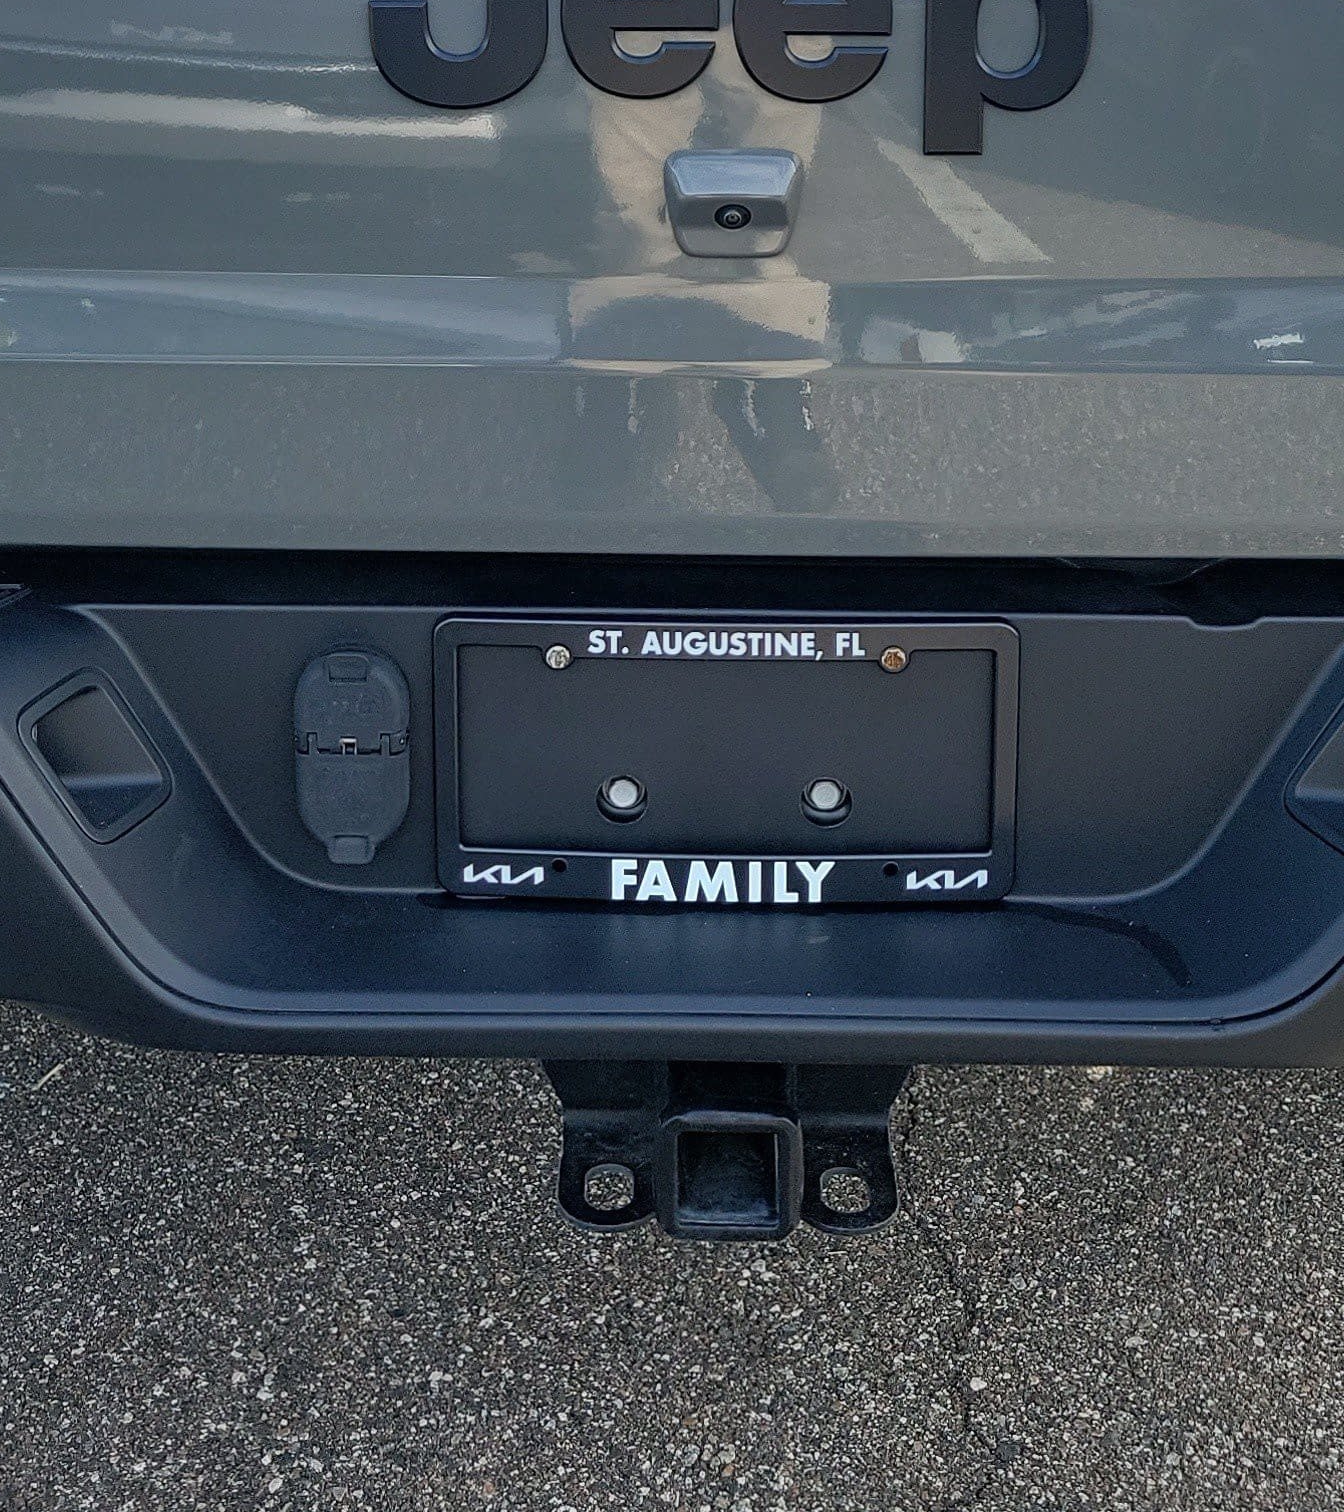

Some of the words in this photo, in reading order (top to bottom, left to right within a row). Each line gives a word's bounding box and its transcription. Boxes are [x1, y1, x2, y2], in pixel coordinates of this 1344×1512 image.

[587, 629, 630, 656] ST.
[641, 630, 824, 661] AUGUSTINE,
[835, 632, 866, 658] FL
[610, 858, 836, 903] FAMILY
